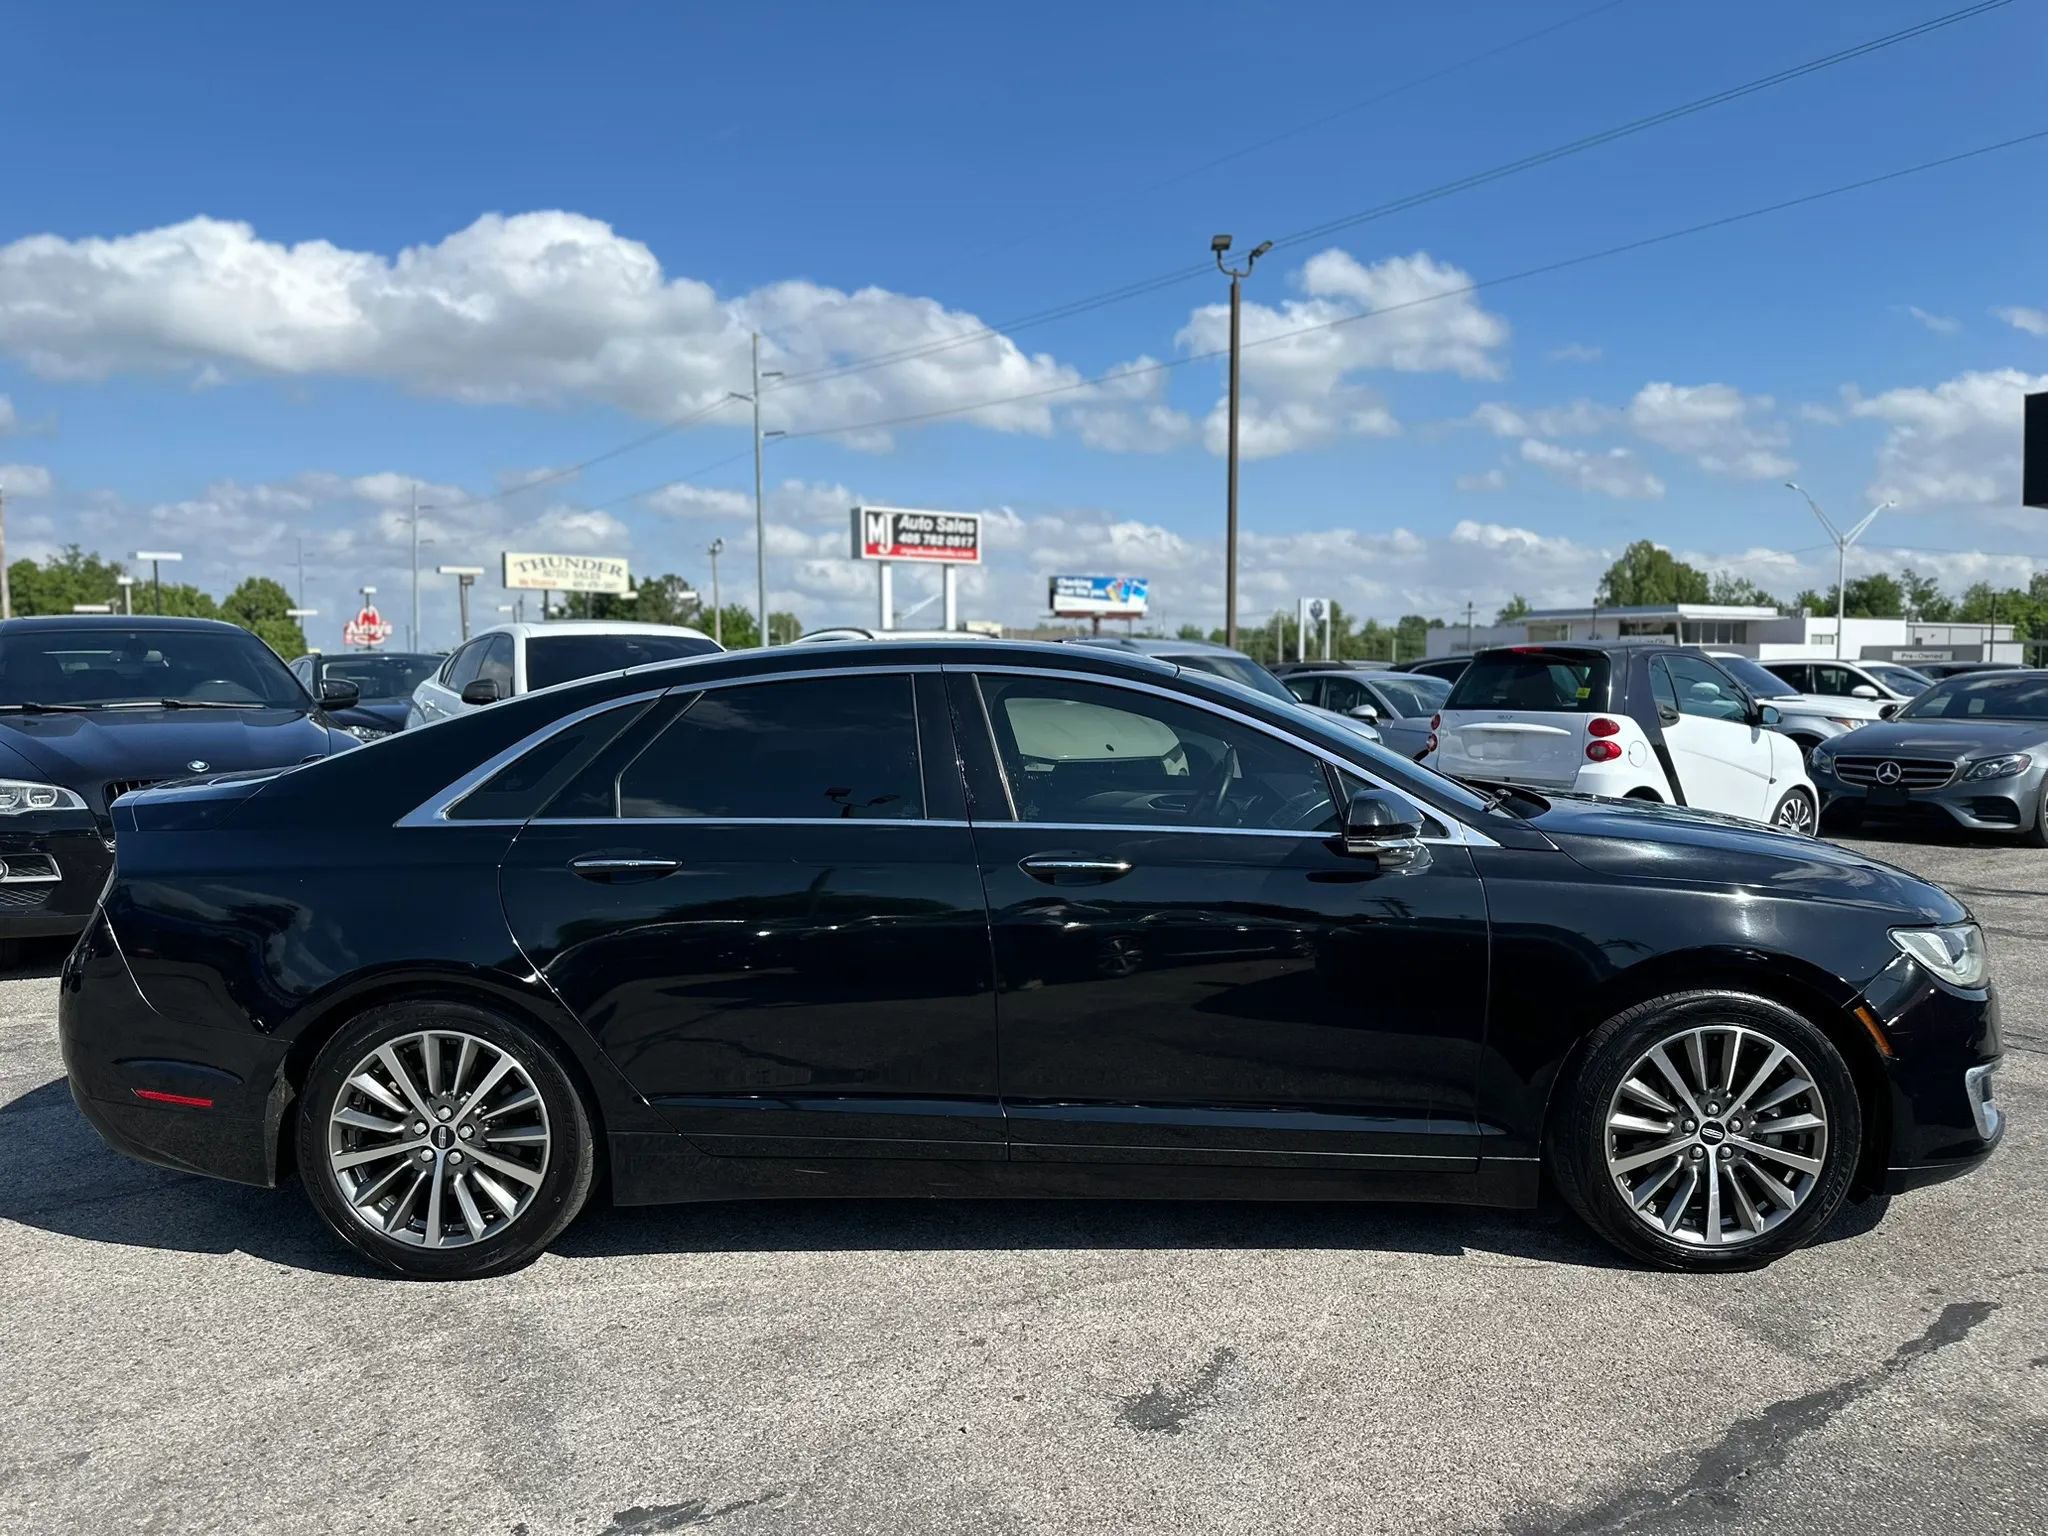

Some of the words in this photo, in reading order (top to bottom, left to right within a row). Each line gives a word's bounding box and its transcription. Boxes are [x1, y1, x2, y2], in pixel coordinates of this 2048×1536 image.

[866, 512, 896, 554] MJ
[898, 514, 934, 531] Auto
[936, 517, 975, 534] Sales
[898, 532, 920, 545] 405
[513, 556, 623, 577] THUNDER
[543, 570, 569, 579] AUTO
[573, 571, 601, 580] SALES
[345, 620, 392, 640] Arby's
